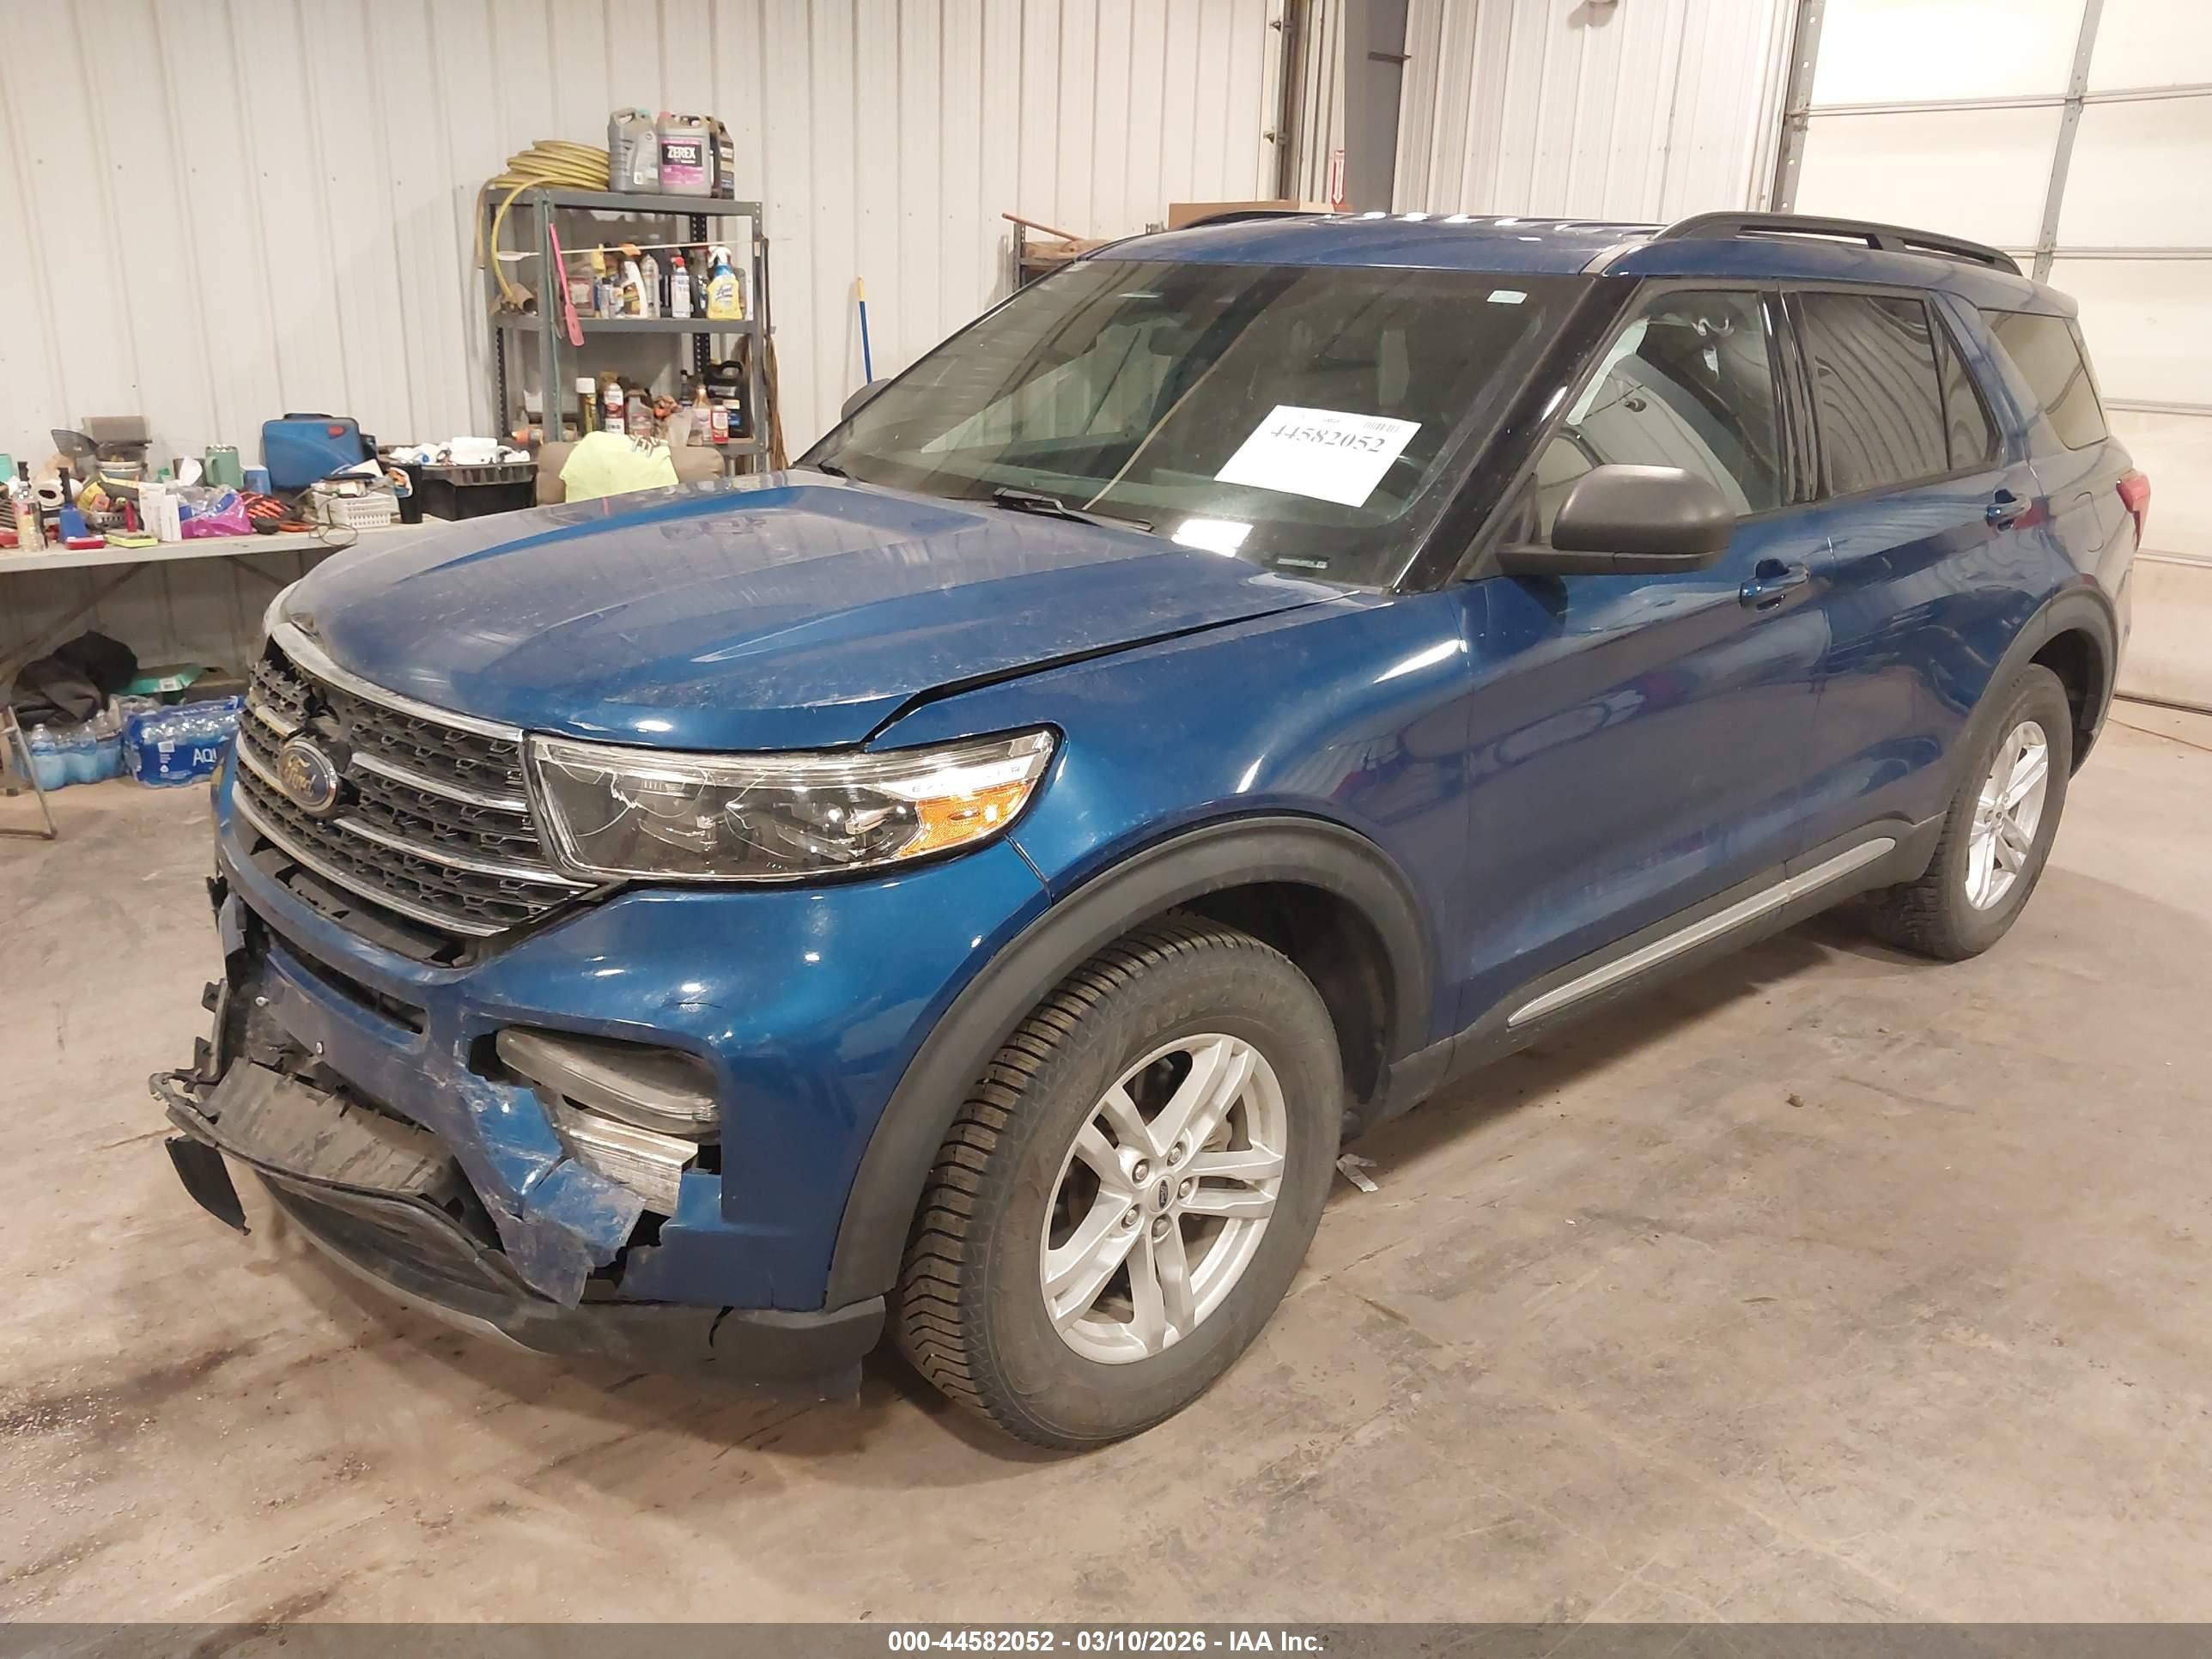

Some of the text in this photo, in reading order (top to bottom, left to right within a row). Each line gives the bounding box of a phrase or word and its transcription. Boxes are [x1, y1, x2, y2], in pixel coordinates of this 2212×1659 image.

[666, 145, 696, 160] ZEREX
[1270, 425, 1385, 453] 44582052
[287, 754, 316, 798] Ford
